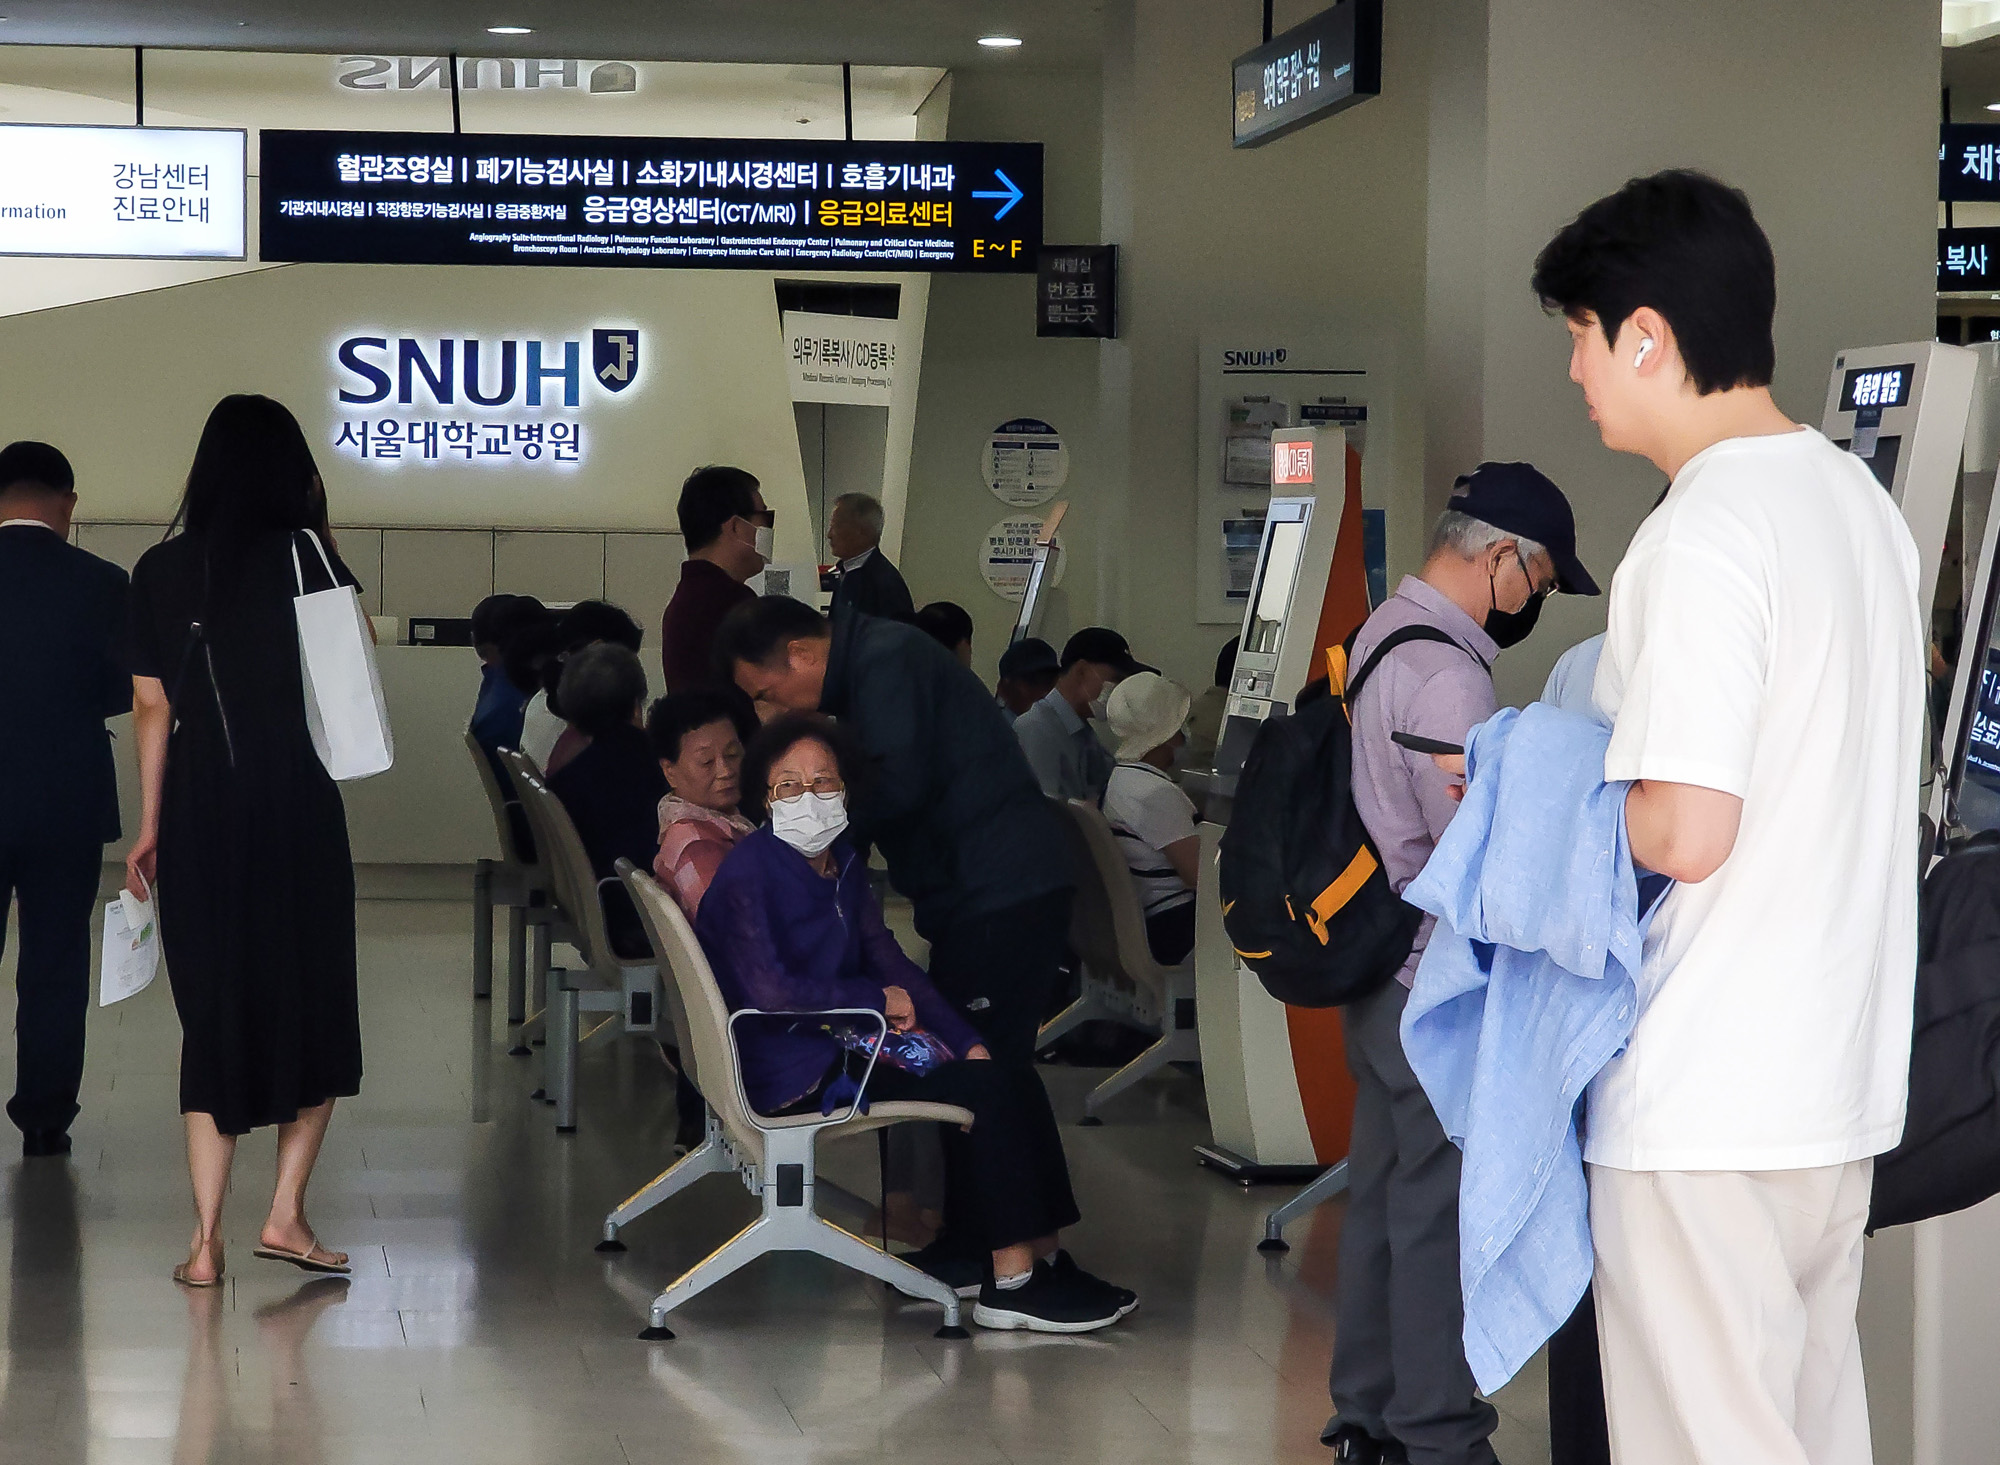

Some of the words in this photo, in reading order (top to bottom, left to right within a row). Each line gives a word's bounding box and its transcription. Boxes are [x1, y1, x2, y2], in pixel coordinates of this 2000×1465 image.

[113, 162, 210, 191] 강남센터
[337, 153, 454, 184] 혈관조영실
[475, 157, 614, 187] 폐기능검사실
[635, 159, 818, 190] 소화기내시경센터
[840, 162, 956, 192] 호흡기내과
[1961, 143, 2000, 182] 채
[1, 203, 67, 220] rmation
[112, 195, 210, 224] 진료안내
[279, 200, 365, 218] 기관지내시경실
[375, 202, 484, 219] 직장항문기능검사실
[494, 203, 568, 221] 응급중환자실
[582, 195, 797, 226] 응급영상센터(CT/MRI)
[818, 199, 953, 228] 응급의료센터
[469, 233, 511, 243] Angiography
[512, 233, 576, 242] Suite-Interventional
[577, 234, 609, 245] Radiology
[615, 235, 649, 245] Pulmonary
[650, 235, 678, 244] Function
[680, 236, 715, 246] Laboratory
[721, 237, 771, 245] Gastrointestinal
[773, 237, 806, 248] Endoscopy
[807, 238, 829, 246] Center
[835, 238, 869, 249] Pulmonary
[870, 239, 882, 247] and
[884, 239, 907, 247] Critical
[908, 239, 923, 248] Care
[925, 240, 954, 248] Medicine
[513, 244, 558, 255] Bronchoscopy
[559, 245, 578, 253] Room
[584, 245, 615, 254] Anorectal
[617, 246, 650, 256] Physiology
[652, 246, 687, 257] Laboratory
[693, 247, 728, 258] Emergency
[729, 248, 757, 256] Intensive
[759, 248, 774, 256] Care
[775, 248, 790, 257] Unit
[796, 249, 830, 259] Emergency
[832, 249, 863, 260] Radiology
[864, 250, 913, 261] Center(CT/MRI)
[919, 251, 954, 261] Emergency
[1946, 245, 1987, 275] 복사
[1047, 282, 1096, 299] 번호표
[338, 336, 580, 407] SNUH
[1224, 351, 1274, 365] SNUH
[335, 419, 579, 461] 서울대학교병원
